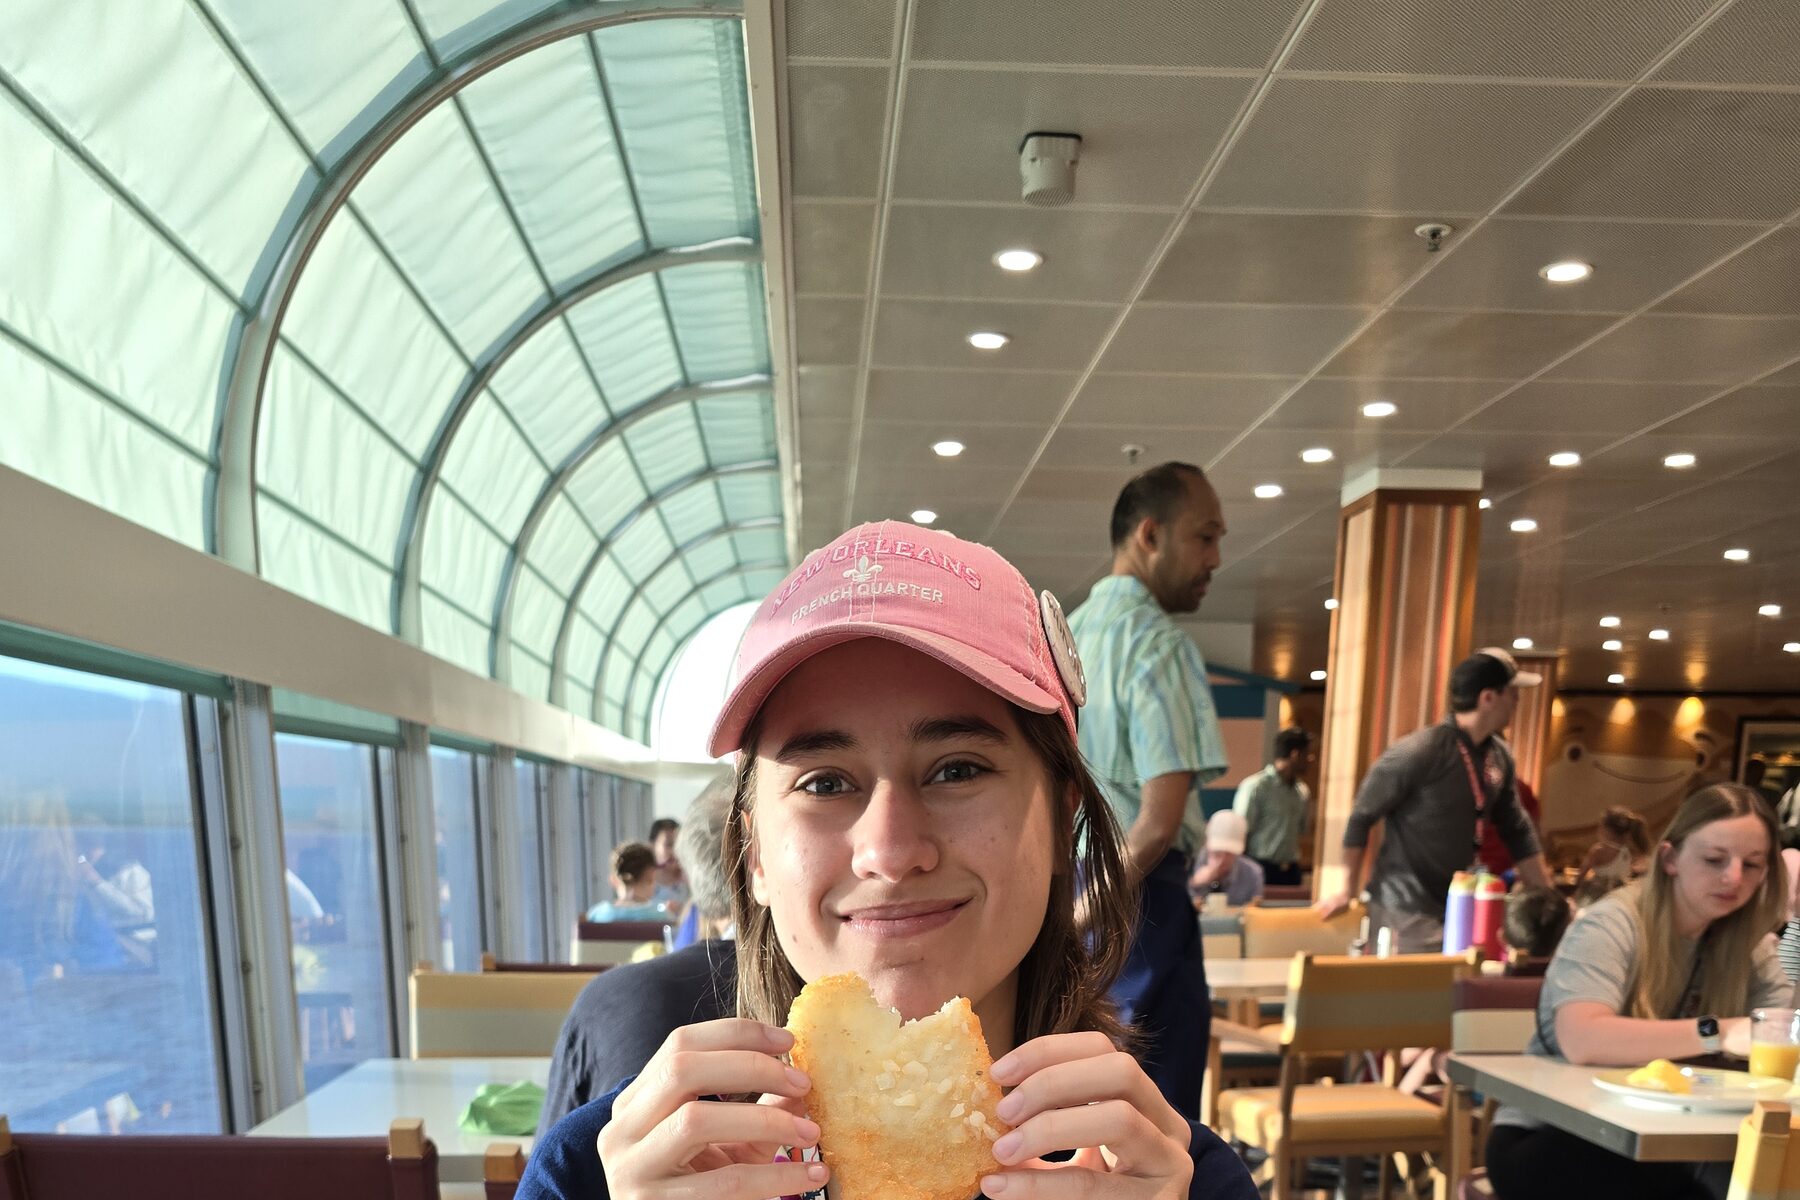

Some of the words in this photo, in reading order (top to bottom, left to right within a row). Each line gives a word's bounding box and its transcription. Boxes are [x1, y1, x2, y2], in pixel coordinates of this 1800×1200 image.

[769, 550, 830, 620] NEW
[831, 539, 982, 591] ORLEANS
[791, 583, 852, 625] FRENCH
[857, 582, 944, 604] QUARTER
